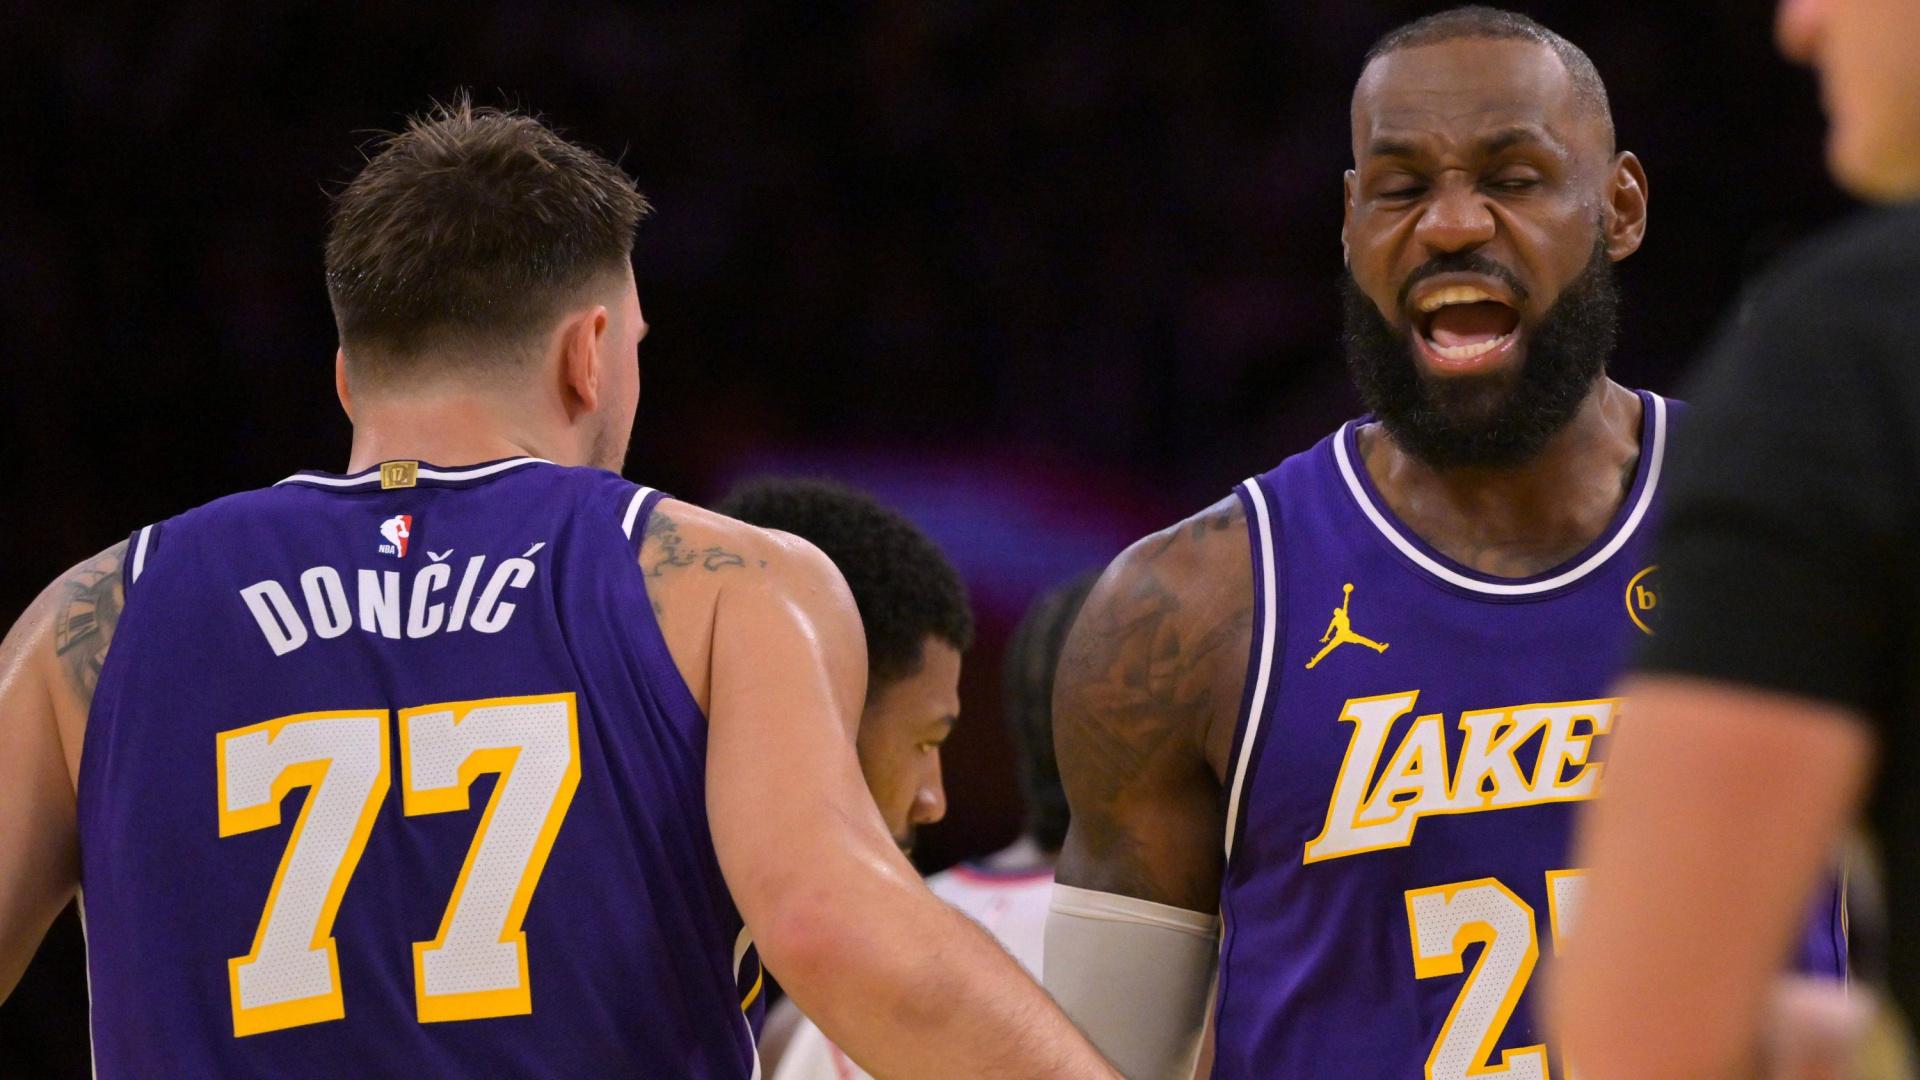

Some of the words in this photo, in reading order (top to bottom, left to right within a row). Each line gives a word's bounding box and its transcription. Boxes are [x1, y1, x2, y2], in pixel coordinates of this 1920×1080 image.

[240, 542, 546, 657] DONČIĆ
[378, 544, 396, 554] NBA
[216, 692, 582, 1038] 77
[1303, 690, 1626, 865] LAKE
[1404, 868, 1596, 1080] 2
